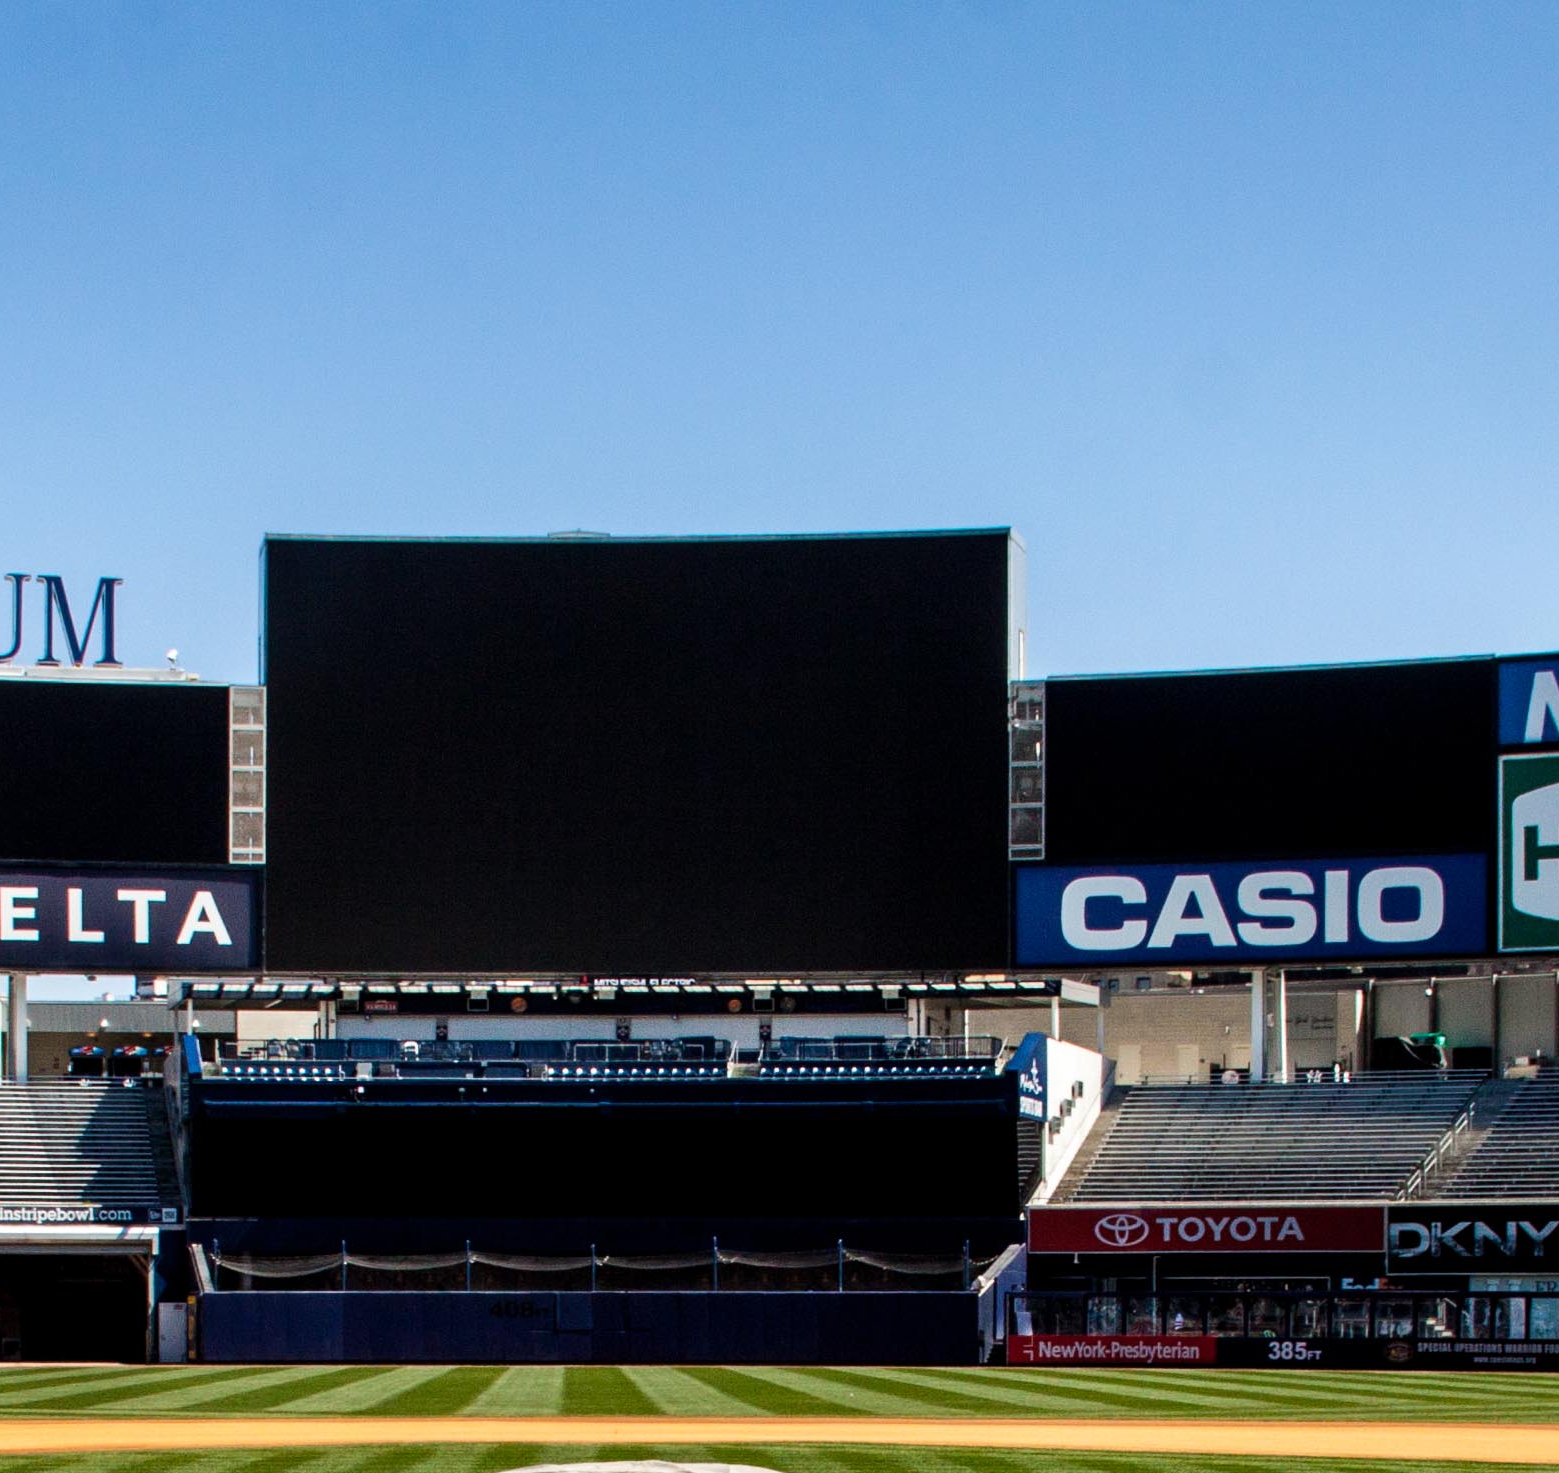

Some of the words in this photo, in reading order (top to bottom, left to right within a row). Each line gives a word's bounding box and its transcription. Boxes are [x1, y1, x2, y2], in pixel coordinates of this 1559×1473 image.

[1061, 866, 1444, 951] CASIO
[1156, 1216, 1305, 1243] TOYOTA
[1417, 1342, 1453, 1353] SPECIAL
[1454, 1343, 1503, 1353] OPERATIONS
